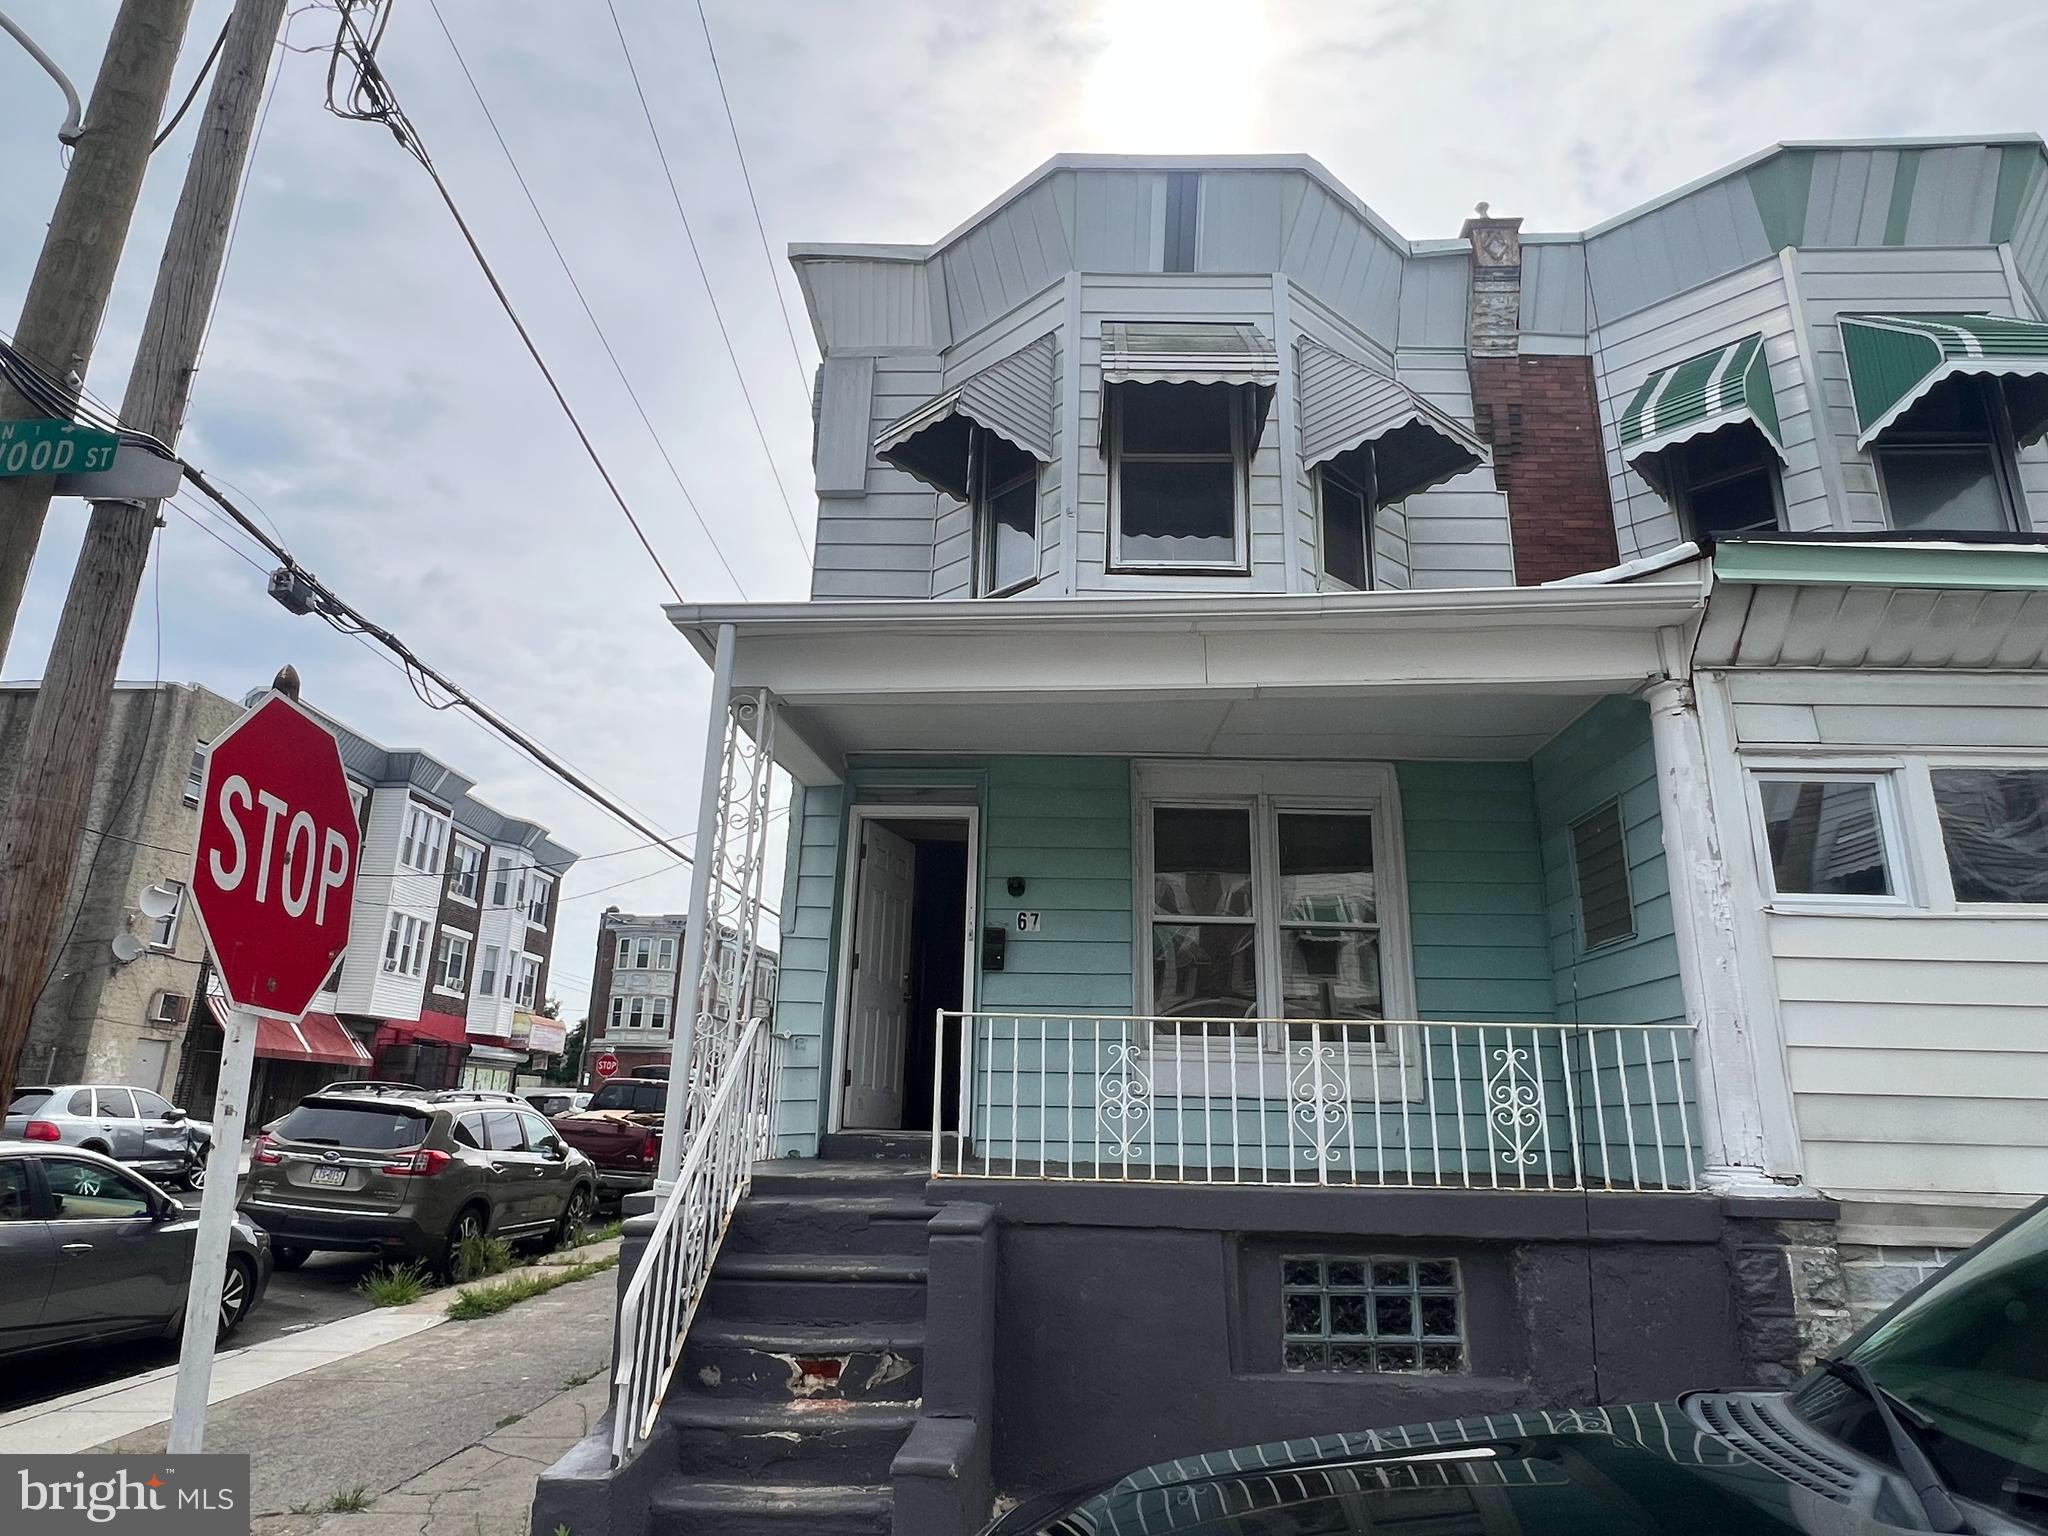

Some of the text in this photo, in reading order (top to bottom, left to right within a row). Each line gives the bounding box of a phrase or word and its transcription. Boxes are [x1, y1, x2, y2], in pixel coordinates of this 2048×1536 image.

[2, 424, 15, 439] N
[0, 440, 112, 472] OOD ST
[209, 774, 350, 926] STOP
[1017, 912, 1040, 931] 67
[598, 1061, 617, 1070] STOP
